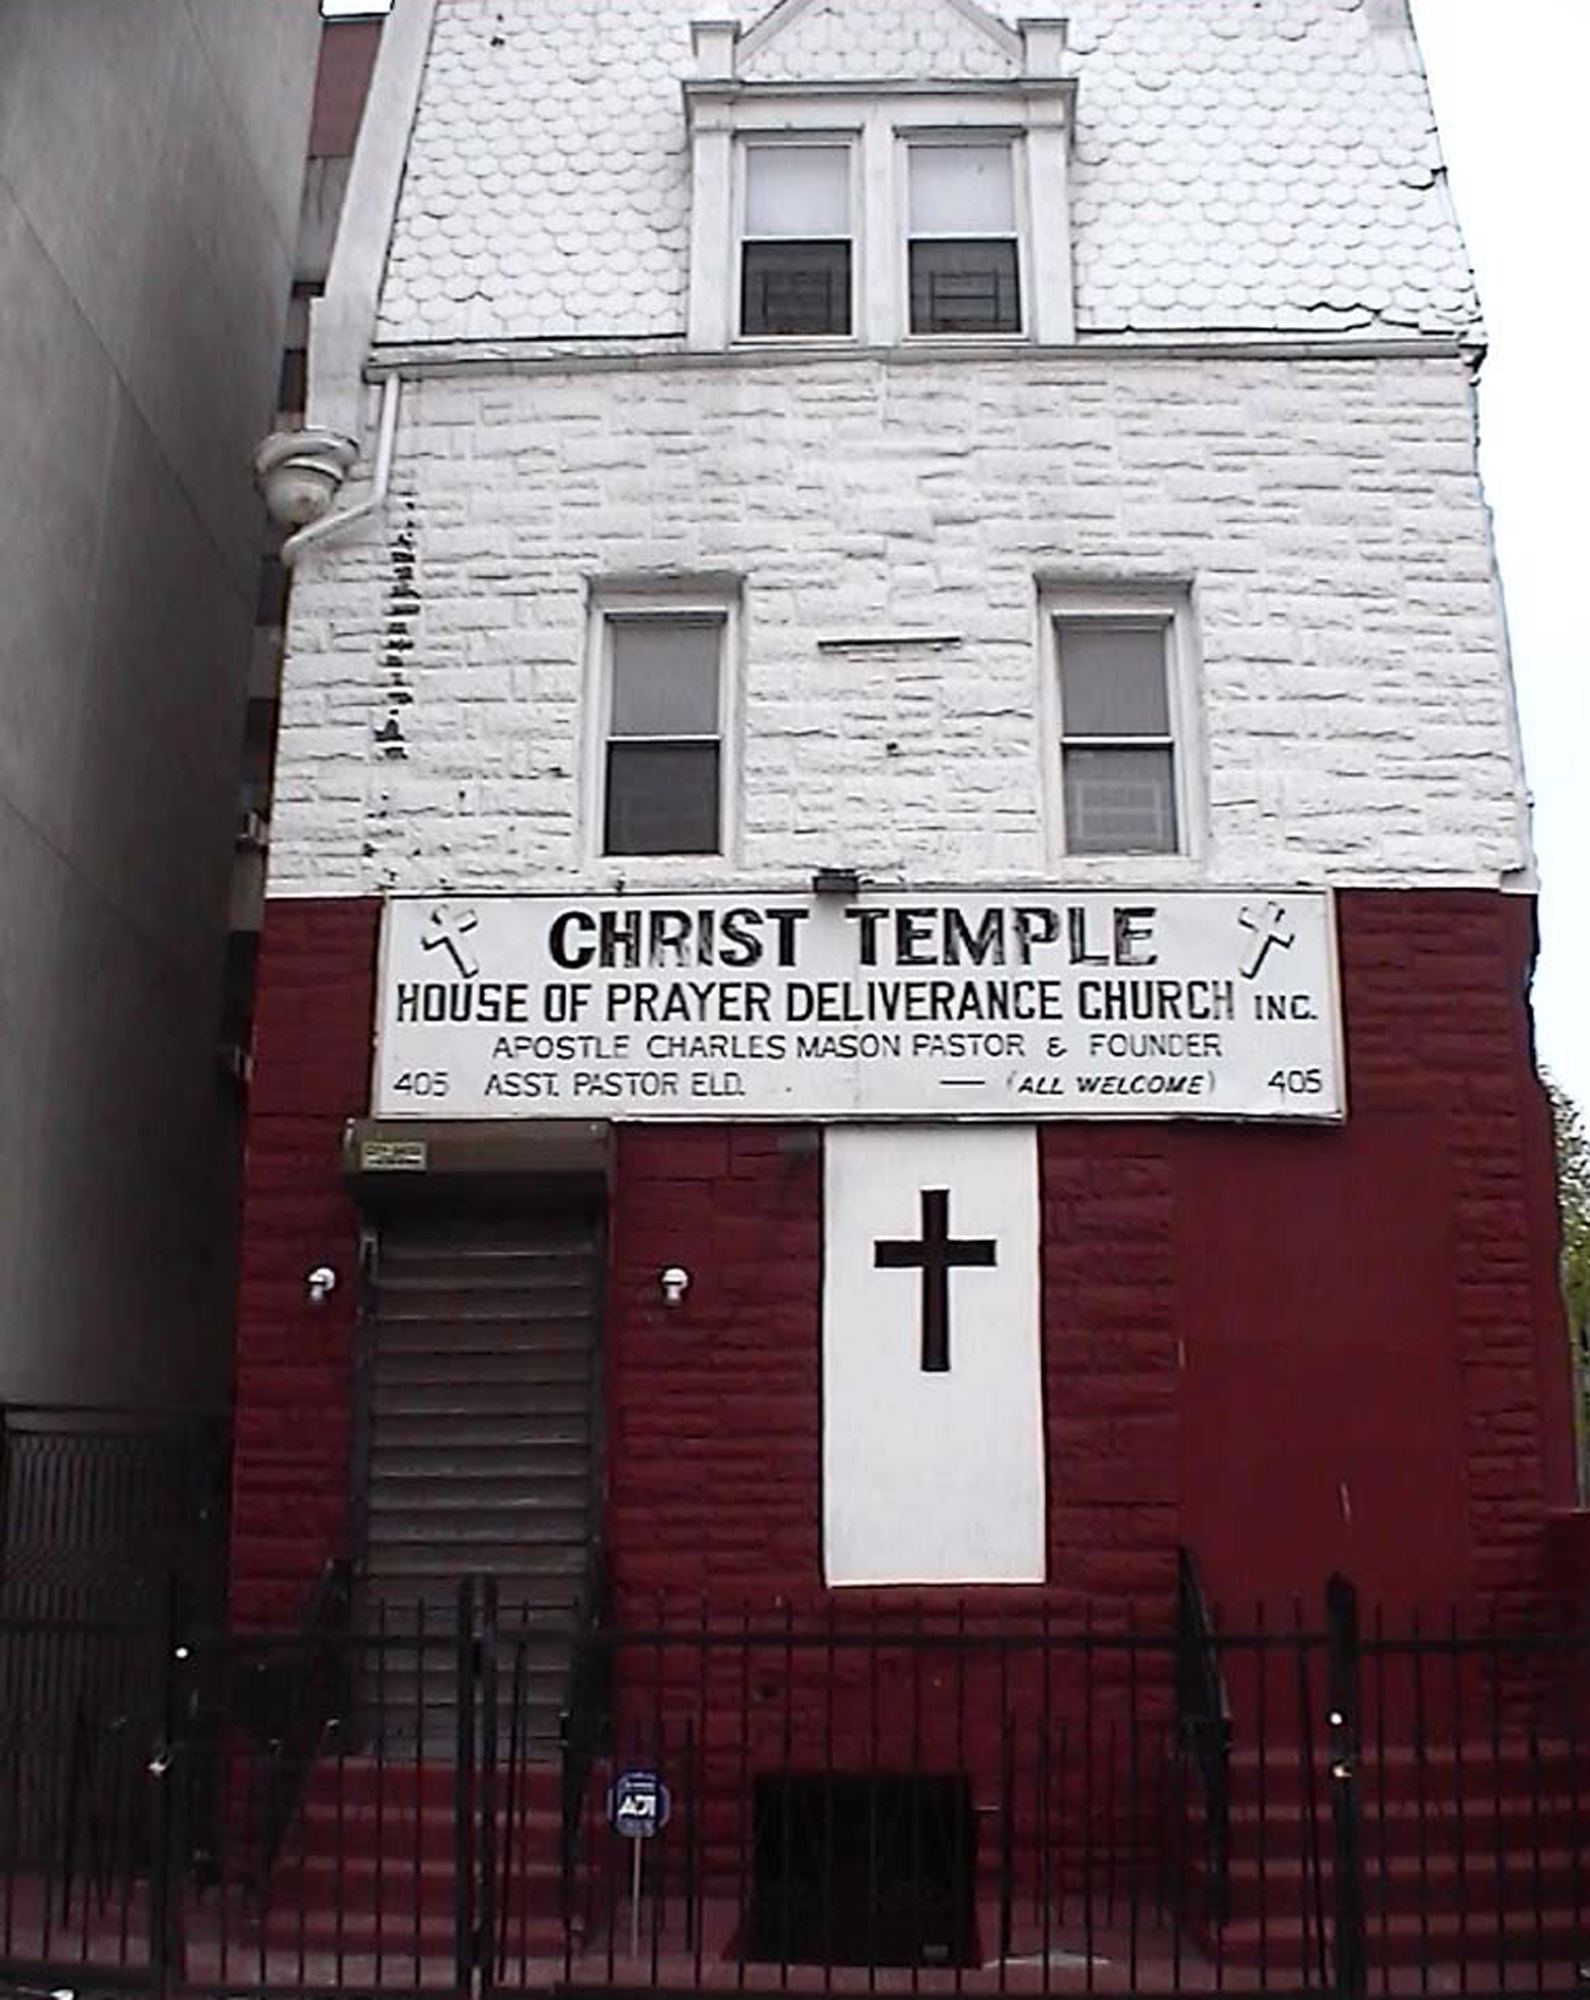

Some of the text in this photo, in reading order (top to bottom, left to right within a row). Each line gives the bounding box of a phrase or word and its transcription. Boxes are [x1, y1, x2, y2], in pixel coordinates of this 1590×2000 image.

[547, 905, 1159, 970] CHRIST TEMPLE
[396, 979, 1319, 1024] HOUSE OF PRAYER DELIVERANCE CHURCH INC.
[491, 1032, 1223, 1061] APOSTLE CHARLES MASON PASTOR & FOUNDER
[392, 1071, 450, 1098] 405
[483, 1071, 560, 1098] ASST.
[573, 1071, 679, 1098] PASTOR
[1006, 1070, 1216, 1096] (ALL WELCOME)
[1267, 1068, 1323, 1095] 405
[618, 1795, 656, 1817] ADT
